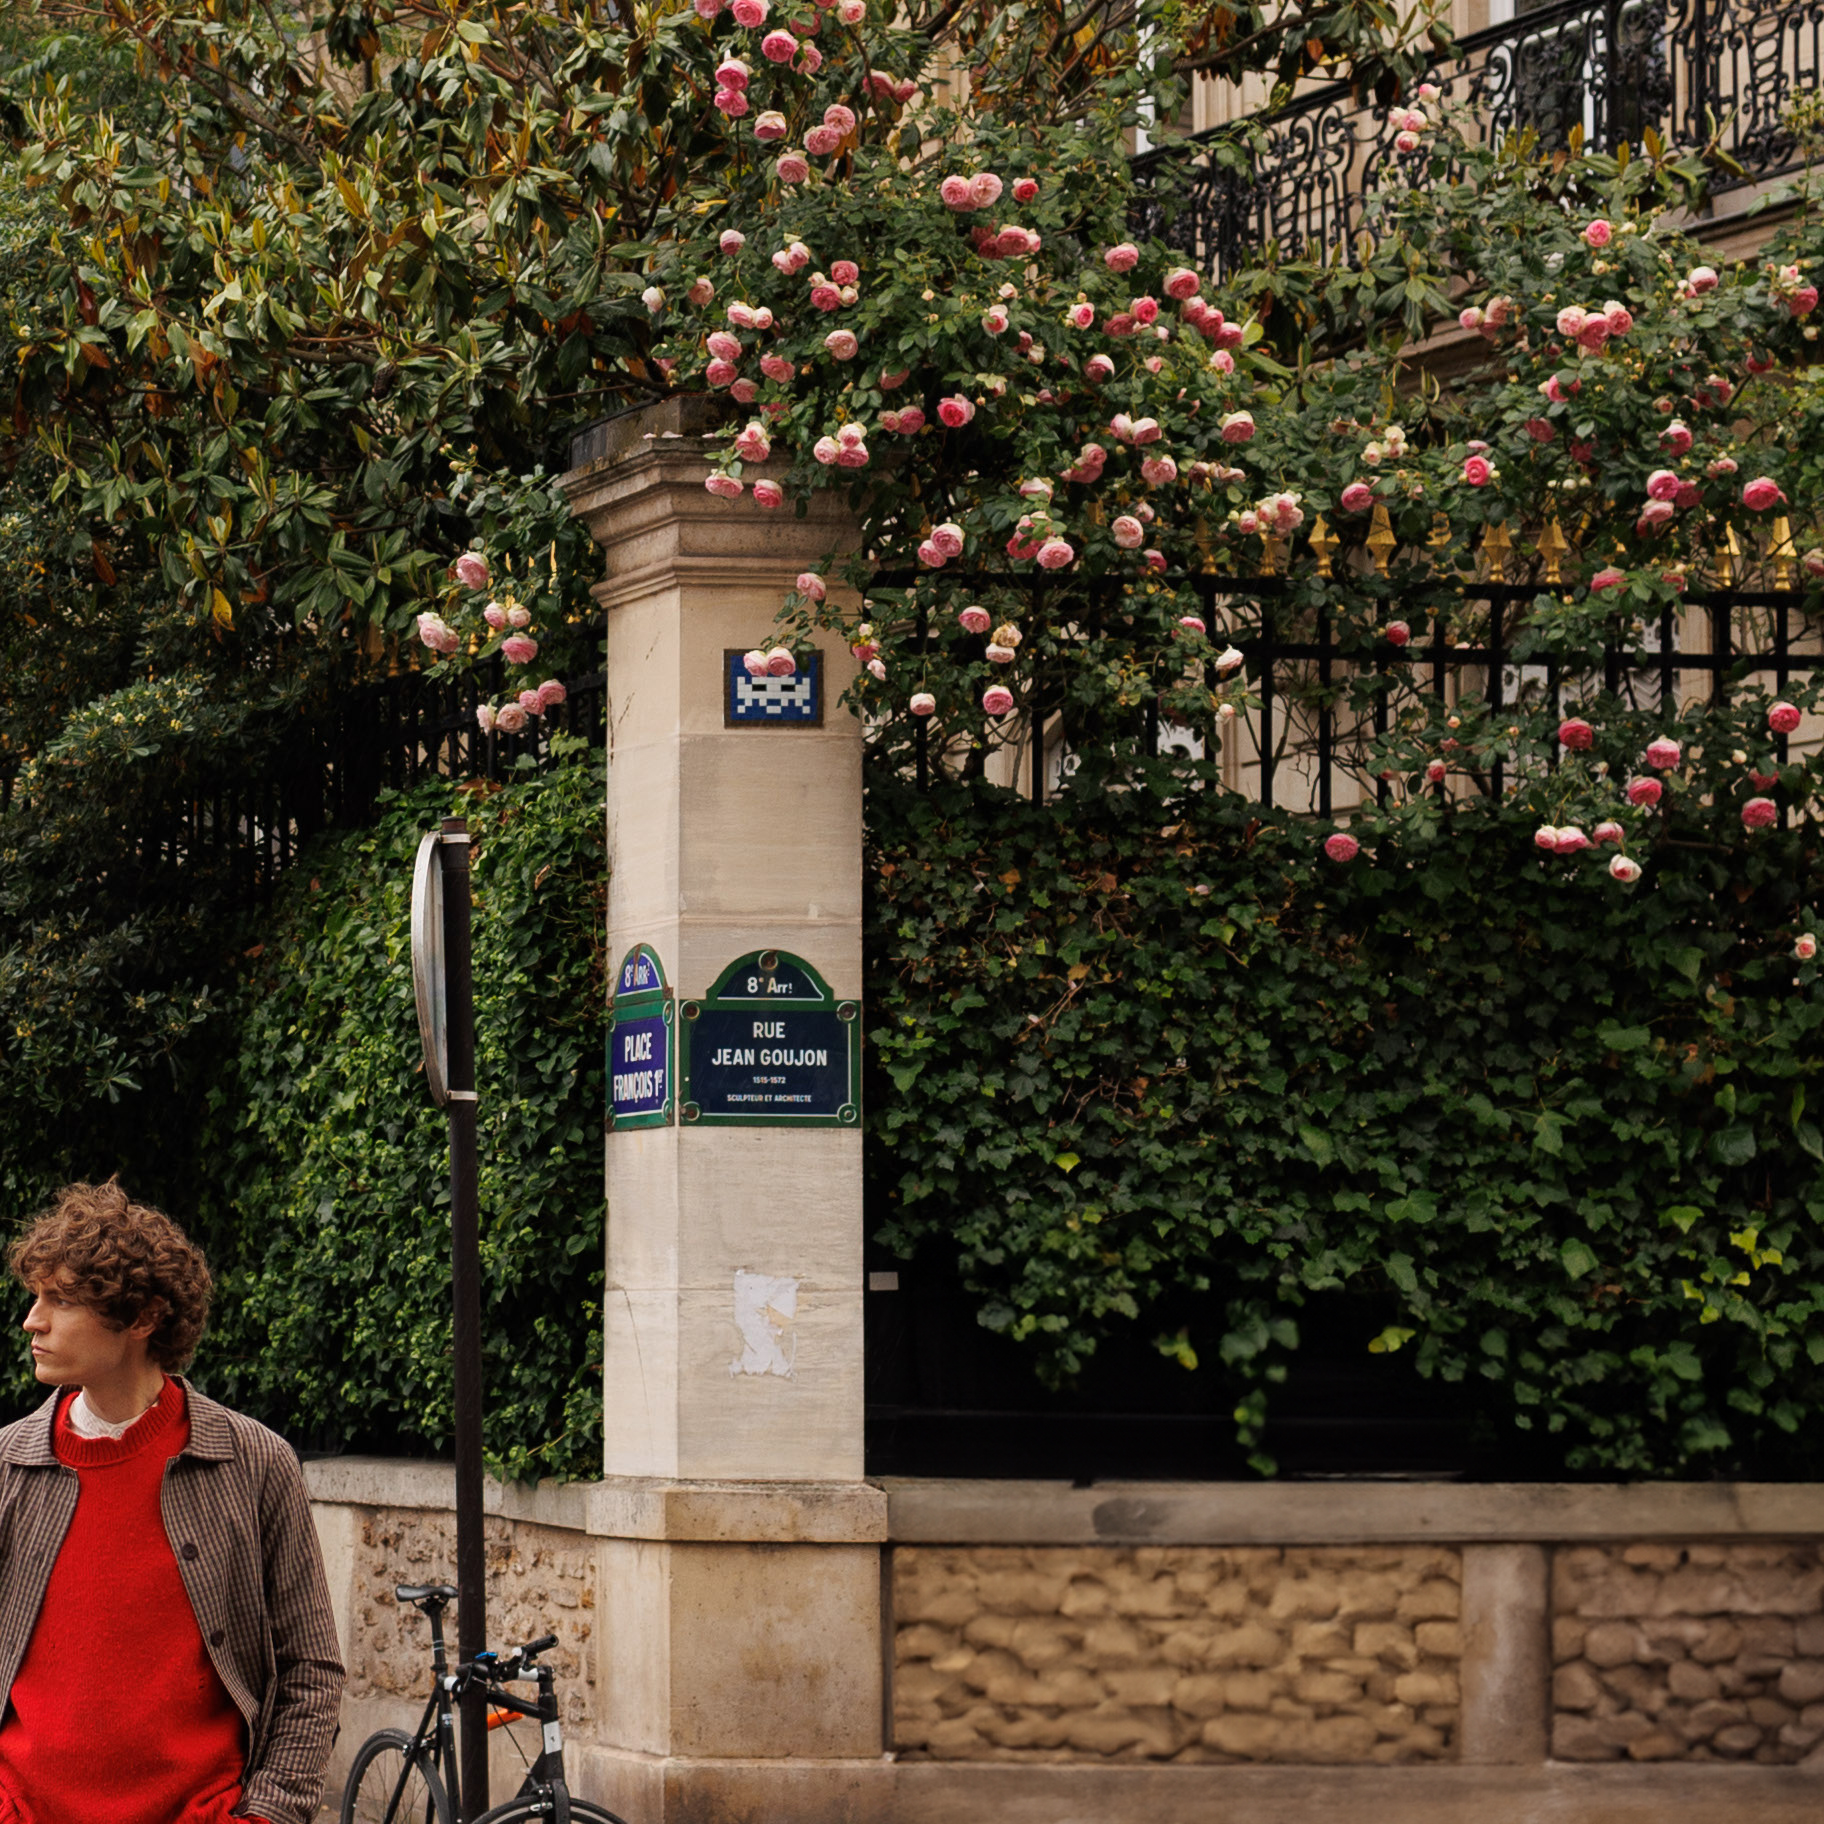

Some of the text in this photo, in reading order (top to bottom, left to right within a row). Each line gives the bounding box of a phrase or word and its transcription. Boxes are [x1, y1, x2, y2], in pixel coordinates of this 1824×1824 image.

[753, 1021, 786, 1038] RUE
[624, 1032, 652, 1063] PLACE
[712, 1048, 827, 1066] JEAN GOUJON
[614, 1070, 653, 1103] FRANÇOIS
[727, 1094, 812, 1103] SCULPTEUR ET ARCHITECTE
